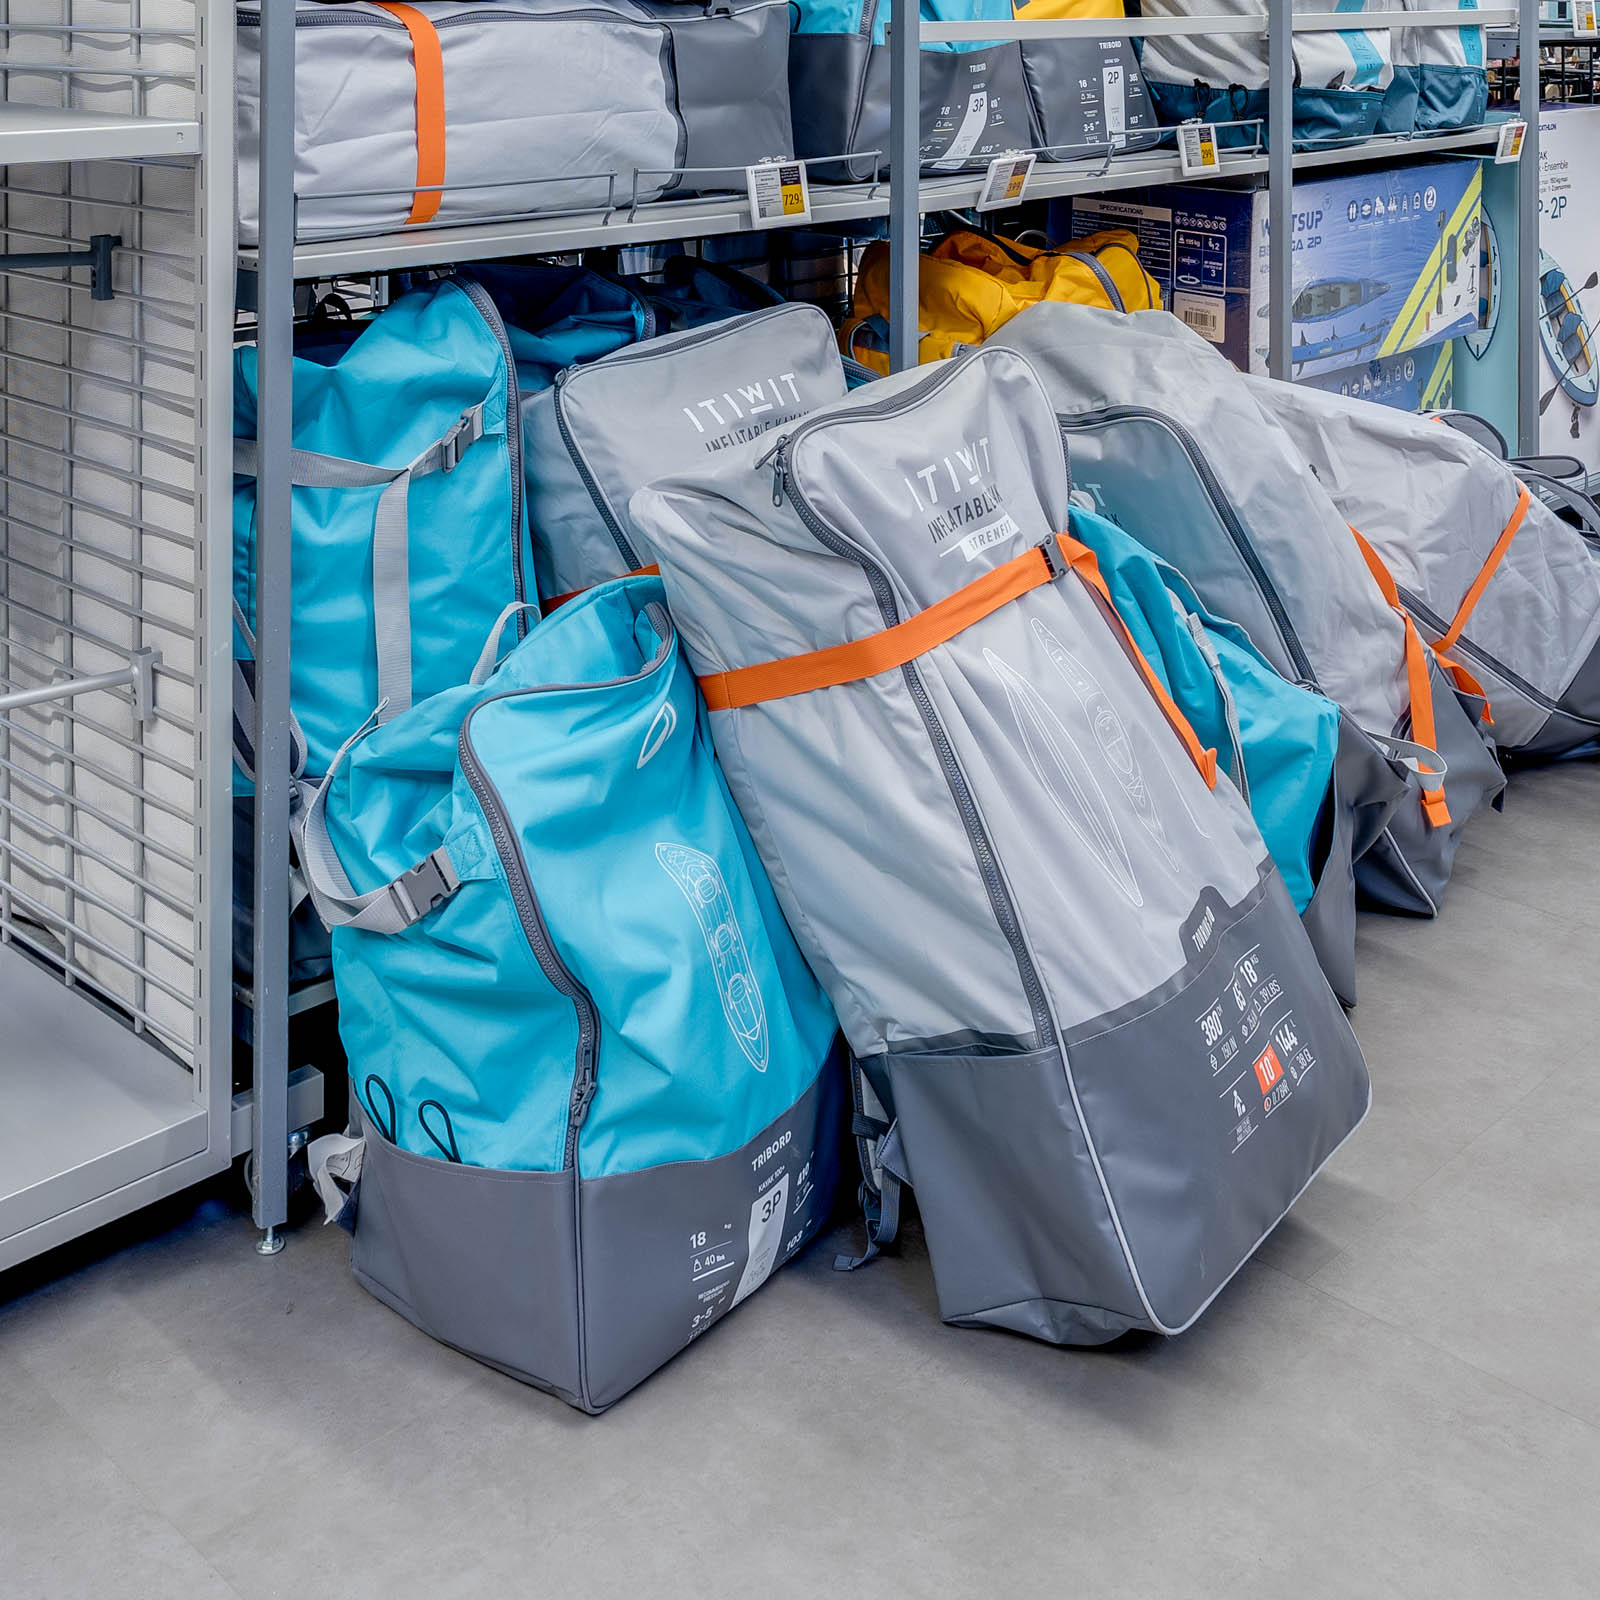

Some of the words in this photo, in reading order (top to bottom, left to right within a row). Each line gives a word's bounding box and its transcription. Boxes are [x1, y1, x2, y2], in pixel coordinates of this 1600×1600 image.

[1098, 40, 1122, 50] TRIBORD
[1107, 71, 1119, 85] 2P
[972, 97, 984, 113] 3P
[783, 193, 800, 207] 729
[1099, 203, 1145, 216] SPECIFICATIONS
[1306, 235, 1322, 249] 2P
[1210, 269, 1217, 277] 3
[683, 372, 801, 433] ITIWIT
[1239, 960, 1258, 987] 18
[1267, 979, 1281, 998] LBS
[1201, 1009, 1223, 1046] 380
[1275, 1023, 1299, 1057] 144
[1258, 1055, 1276, 1086] 10
[752, 1130, 792, 1172] TRIBORD
[758, 1174, 775, 1193] KAYAK
[761, 1190, 782, 1223] 3P
[689, 1231, 706, 1249] 18
[704, 1253, 716, 1266] 40
[692, 1304, 714, 1328] 3-5
